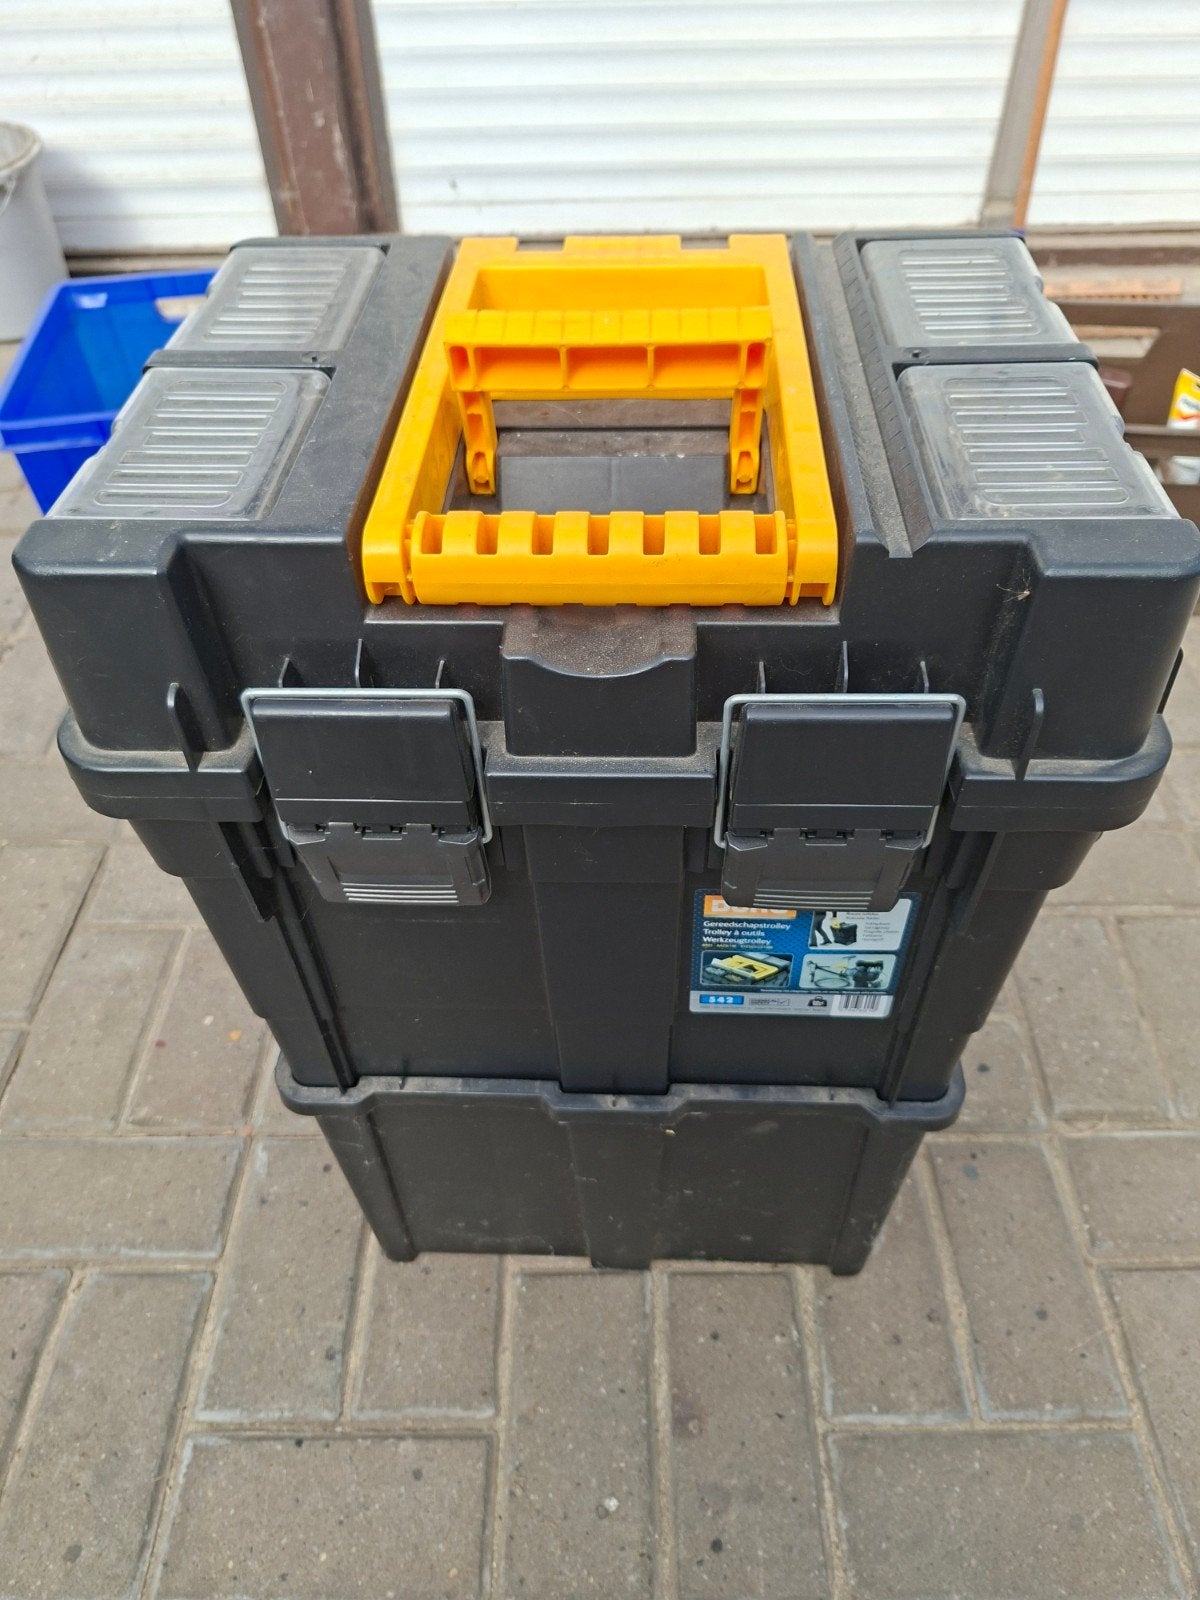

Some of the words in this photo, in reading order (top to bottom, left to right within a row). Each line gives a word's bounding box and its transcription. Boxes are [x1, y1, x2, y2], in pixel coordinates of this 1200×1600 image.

[703, 920, 791, 930] Gereedschapstrolley
[703, 928, 732, 937] Trolley
[702, 936, 771, 946] Werkzeugtrolley
